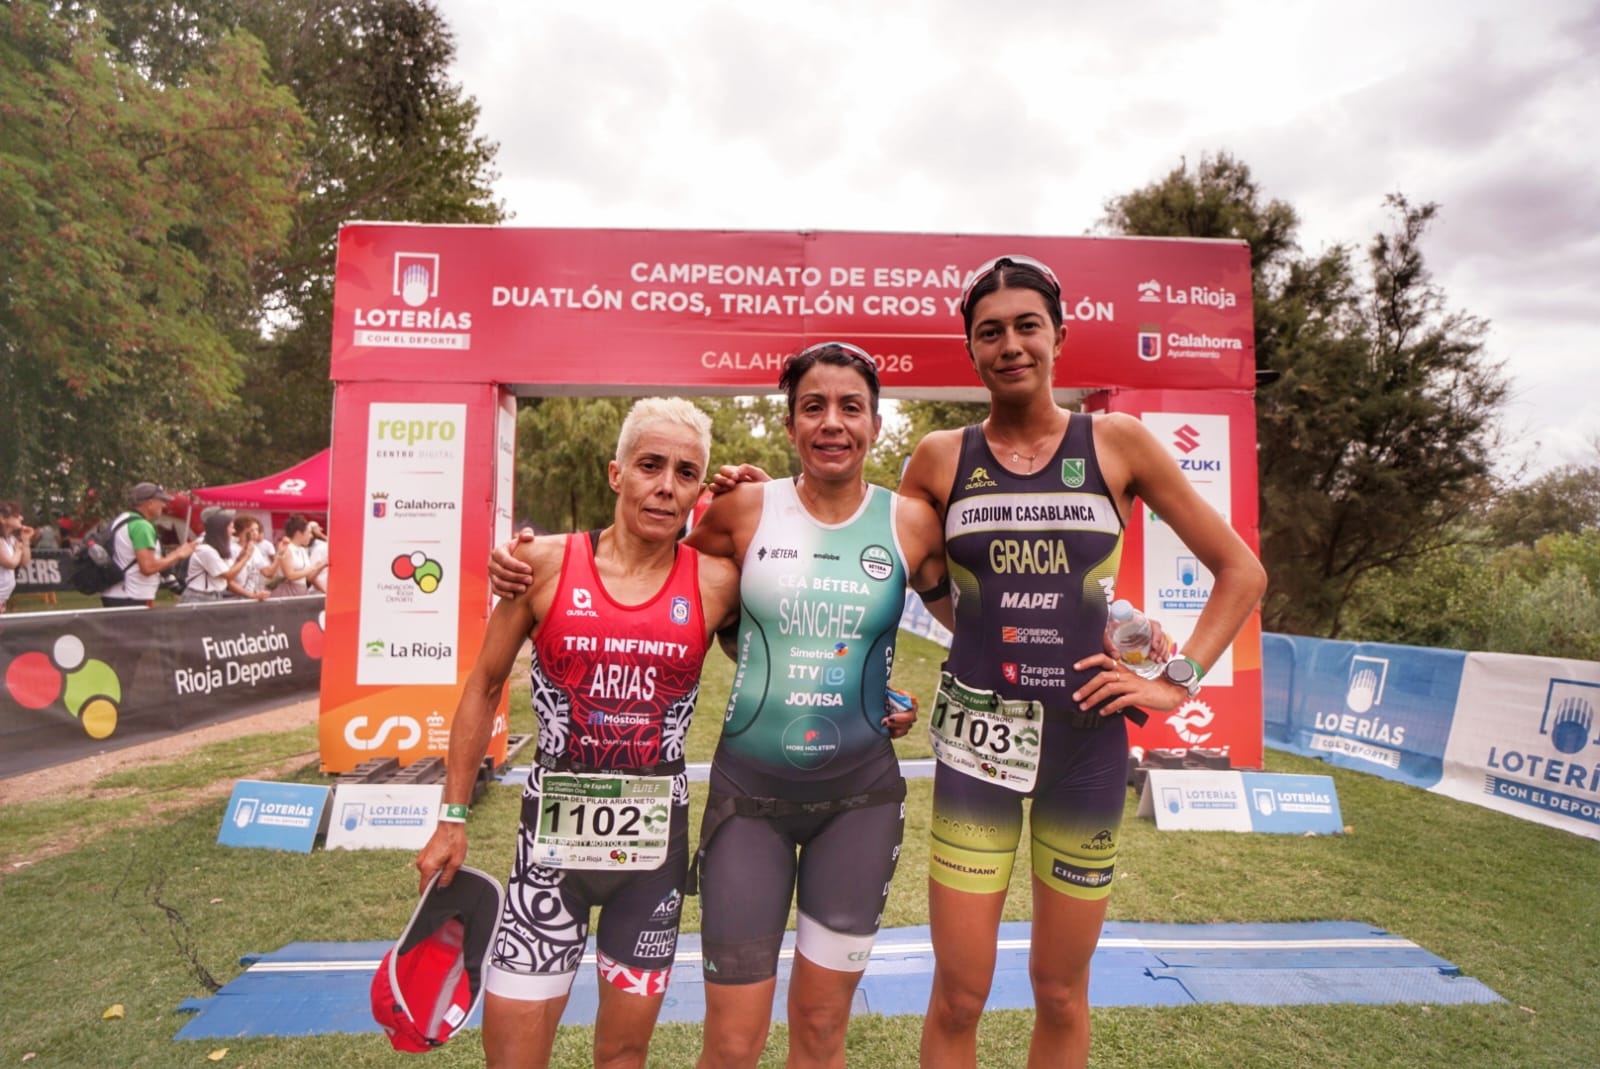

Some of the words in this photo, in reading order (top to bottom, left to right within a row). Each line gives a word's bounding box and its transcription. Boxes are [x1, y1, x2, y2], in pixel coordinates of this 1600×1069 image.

[630, 262, 822, 287] CAMPEONATO
[830, 266, 865, 287] DE
[492, 284, 622, 310] DUATLÓN
[631, 291, 711, 316] CROS,
[720, 290, 854, 315] TRIATLÓN
[863, 296, 936, 316] CROS
[944, 298, 962, 316] Y
[1166, 285, 1187, 304] La
[1190, 286, 1236, 309] Rioja
[354, 307, 472, 330] LOTERÍAS
[409, 336, 457, 345] DEPORTE
[1167, 333, 1242, 349] Calahorra
[702, 351, 785, 371] CALAH
[873, 354, 913, 372] 026
[377, 418, 456, 446] repro
[1179, 459, 1221, 471] ZUKI
[394, 499, 455, 510] Calahorra
[961, 506, 1012, 525] STADIUM
[1016, 505, 1096, 522] CASABLANCA
[770, 548, 798, 559] BÉTERA
[989, 539, 1070, 574] GRACIA
[812, 577, 870, 595] BÉTERA
[1158, 587, 1209, 598] LOTERÍA
[1000, 592, 1058, 609] MAPEI
[779, 591, 865, 639] SÁNCHEZ
[202, 625, 289, 660] Fundación
[391, 643, 407, 657] La
[412, 642, 452, 660] Rioja
[563, 636, 597, 651] TRI
[604, 637, 688, 660] INFINITY
[175, 664, 222, 695] Rioja
[226, 656, 293, 687] Deporte
[788, 664, 820, 680] ITV
[1020, 664, 1065, 677] Zaragoza
[589, 663, 657, 701] ARIAS
[1020, 675, 1066, 687] DEPORTE
[785, 692, 843, 706] JOVISA
[604, 714, 650, 724] Móstoles
[936, 703, 1010, 754] 1103
[1487, 746, 1600, 793] LOTERÍ
[1186, 790, 1238, 800] LOTERÍAS
[1277, 791, 1330, 804] LOTERÍAS
[1500, 783, 1527, 799] CON
[1531, 791, 1546, 804] EL
[1550, 796, 1600, 819] DEPOR
[260, 802, 314, 817] LOTERÍAS
[369, 805, 428, 816] LOTERÍAS
[545, 802, 641, 836] 1102
